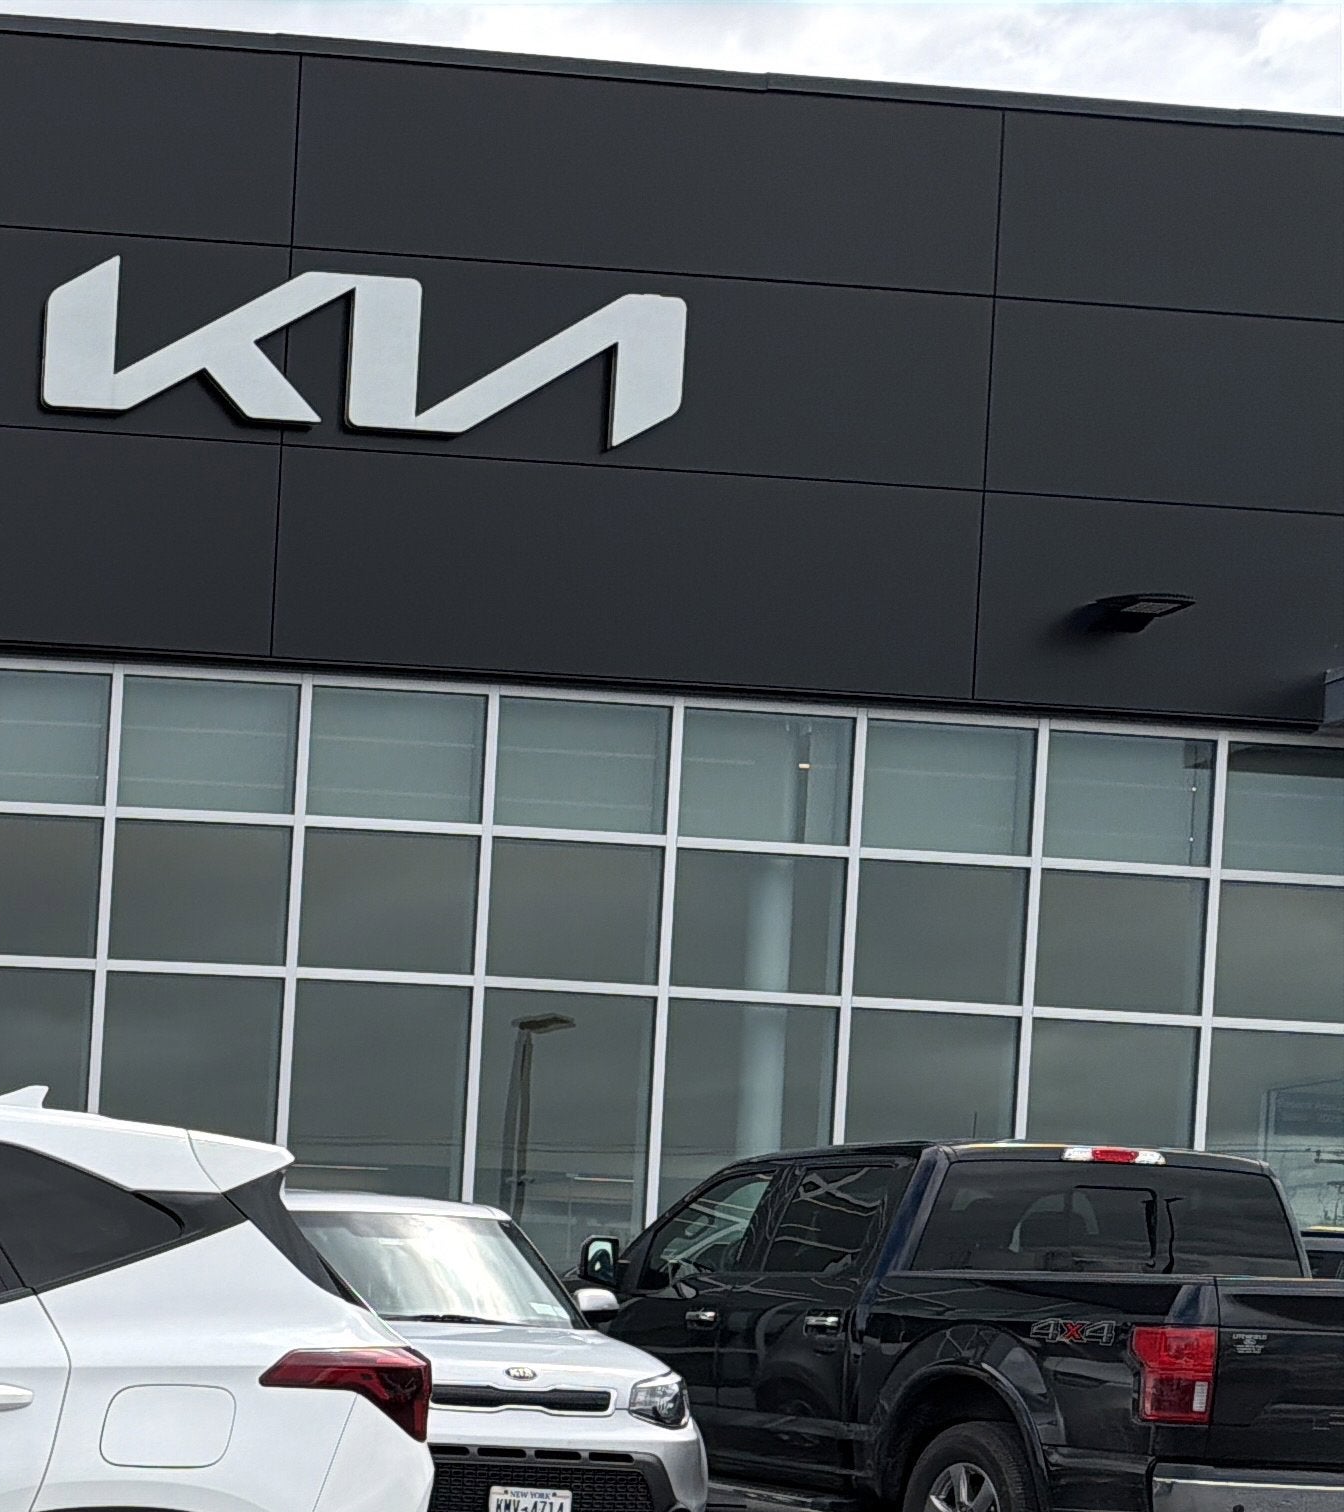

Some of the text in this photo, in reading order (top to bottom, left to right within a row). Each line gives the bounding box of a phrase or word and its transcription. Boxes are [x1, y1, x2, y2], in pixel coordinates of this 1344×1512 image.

[42, 254, 687, 449] KIA
[507, 1366, 535, 1378] KIA
[510, 1489, 552, 1501] NEW YORK
